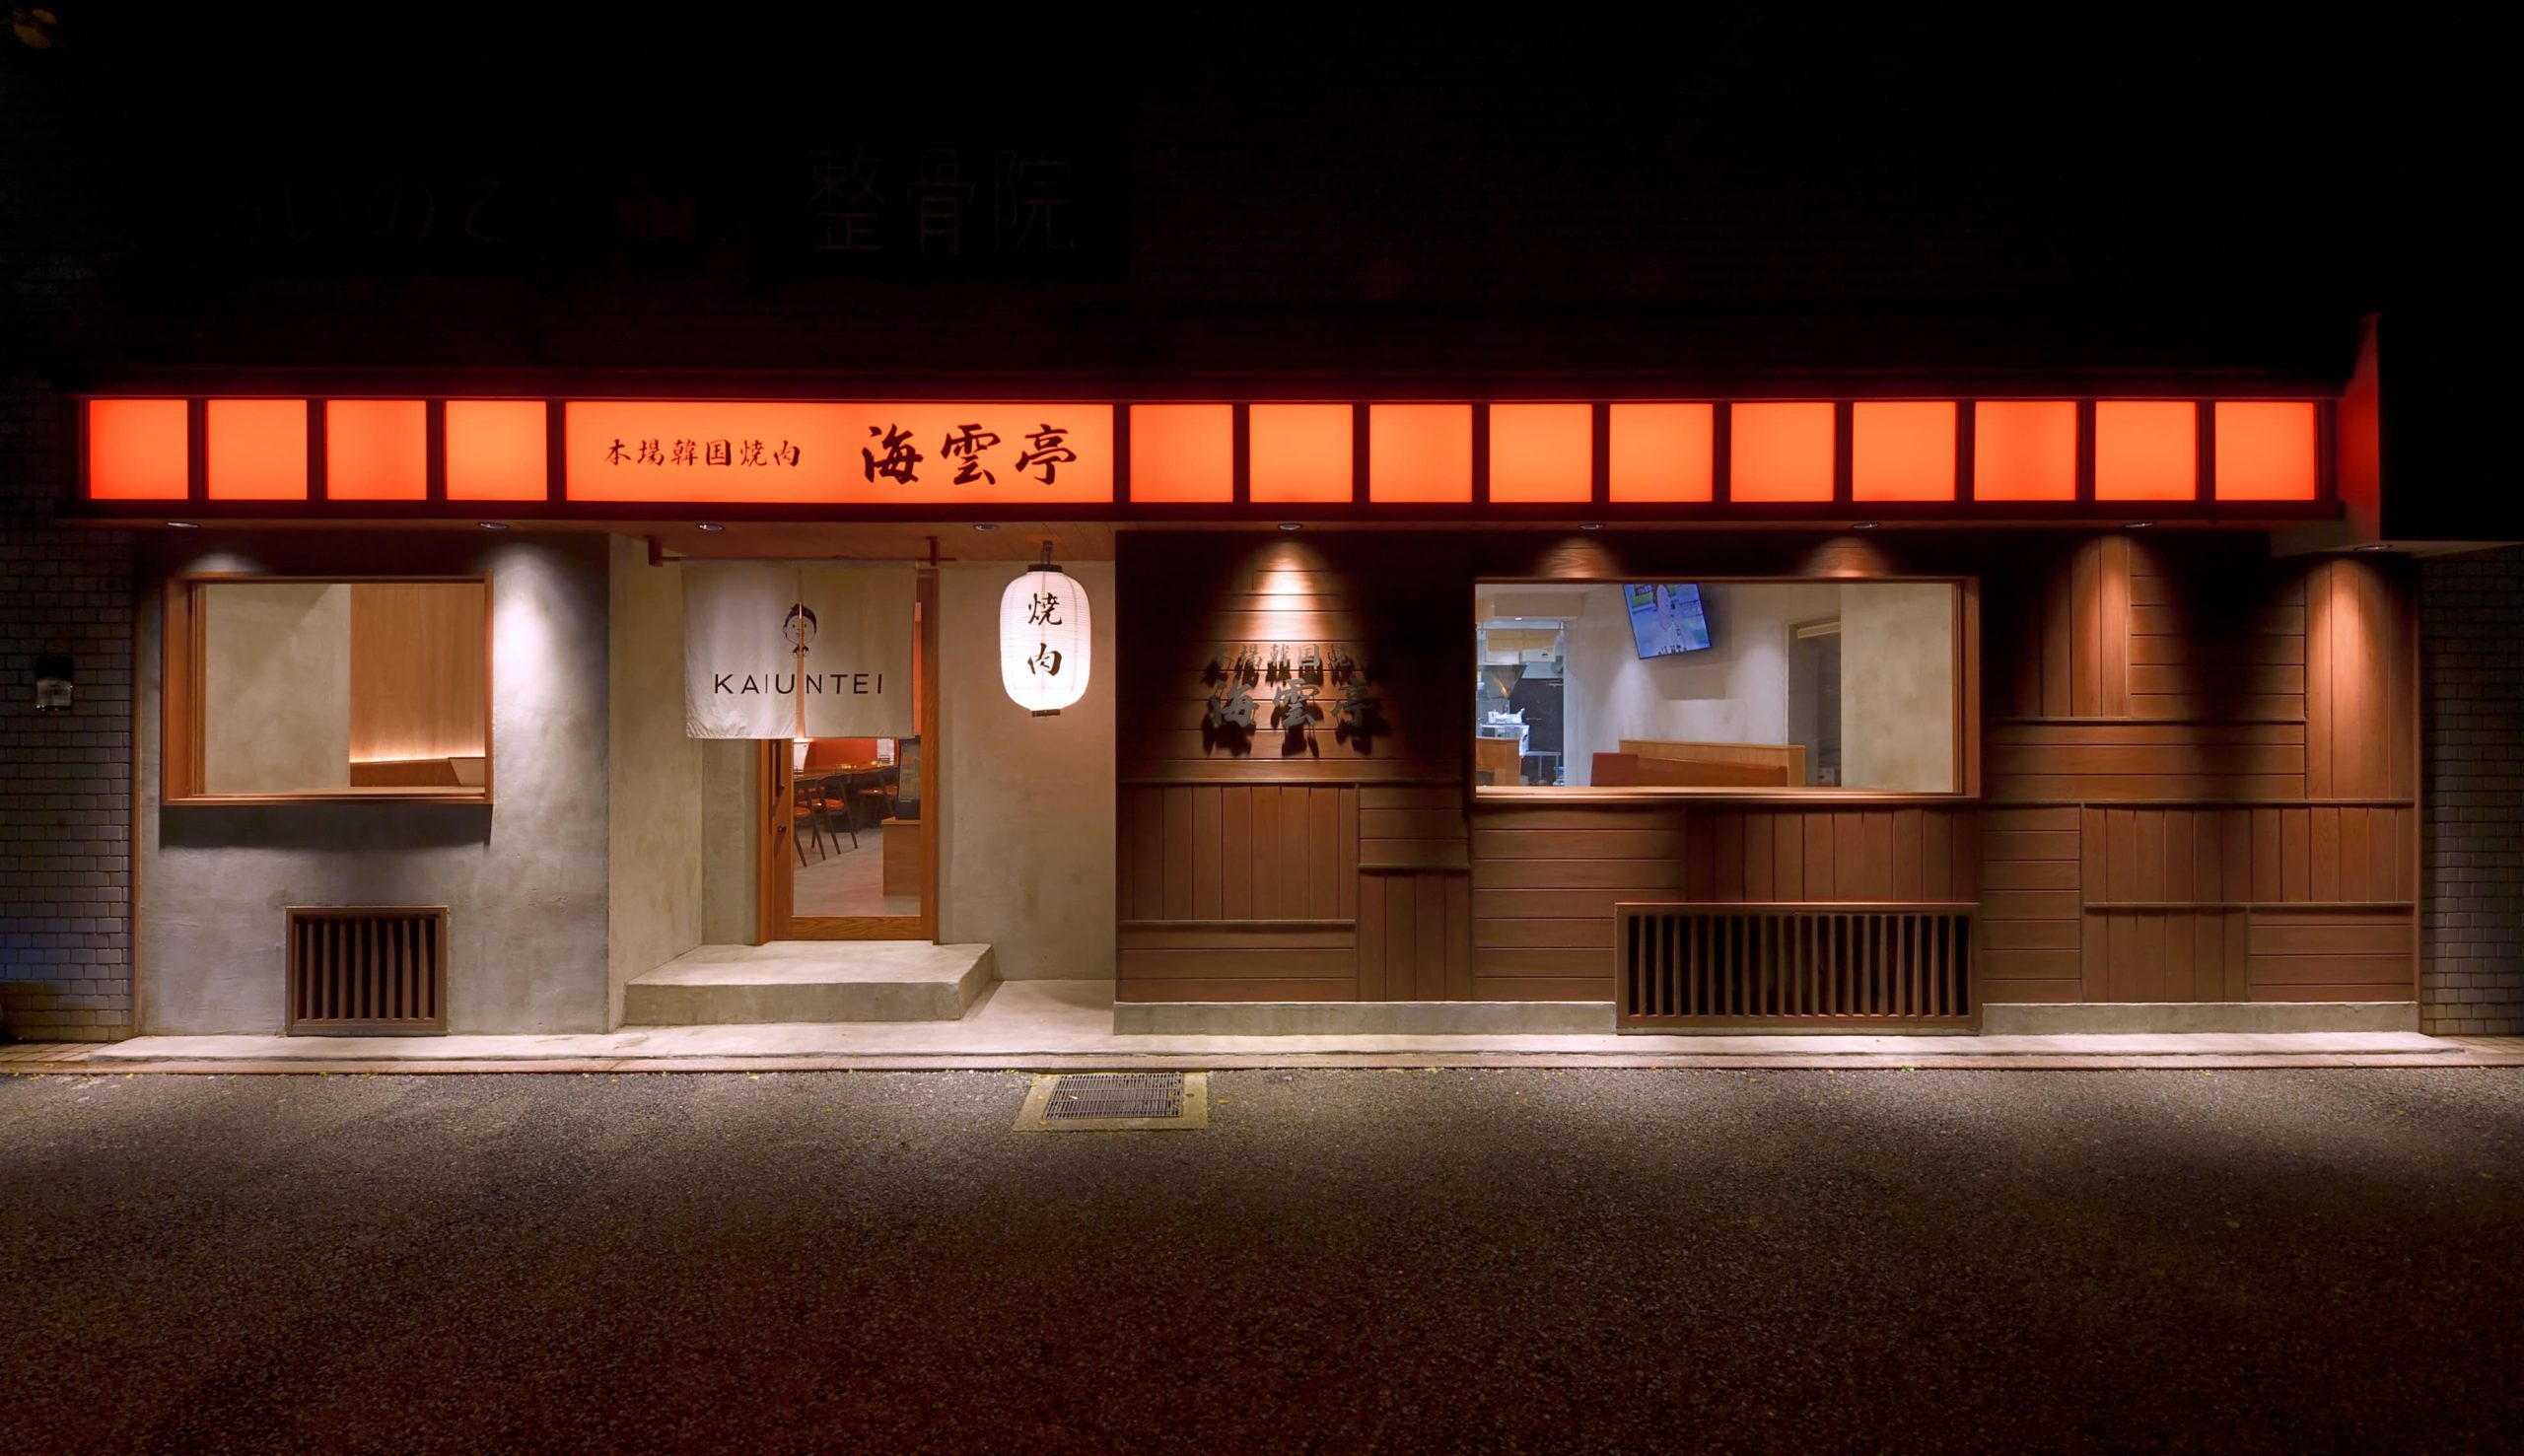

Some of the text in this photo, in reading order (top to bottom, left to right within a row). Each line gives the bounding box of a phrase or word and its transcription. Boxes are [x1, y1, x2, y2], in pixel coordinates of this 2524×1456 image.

[862, 424, 1077, 485] 海雲亭
[1027, 592, 1062, 677] 焼肉
[714, 672, 882, 695] KAIUNTEI
